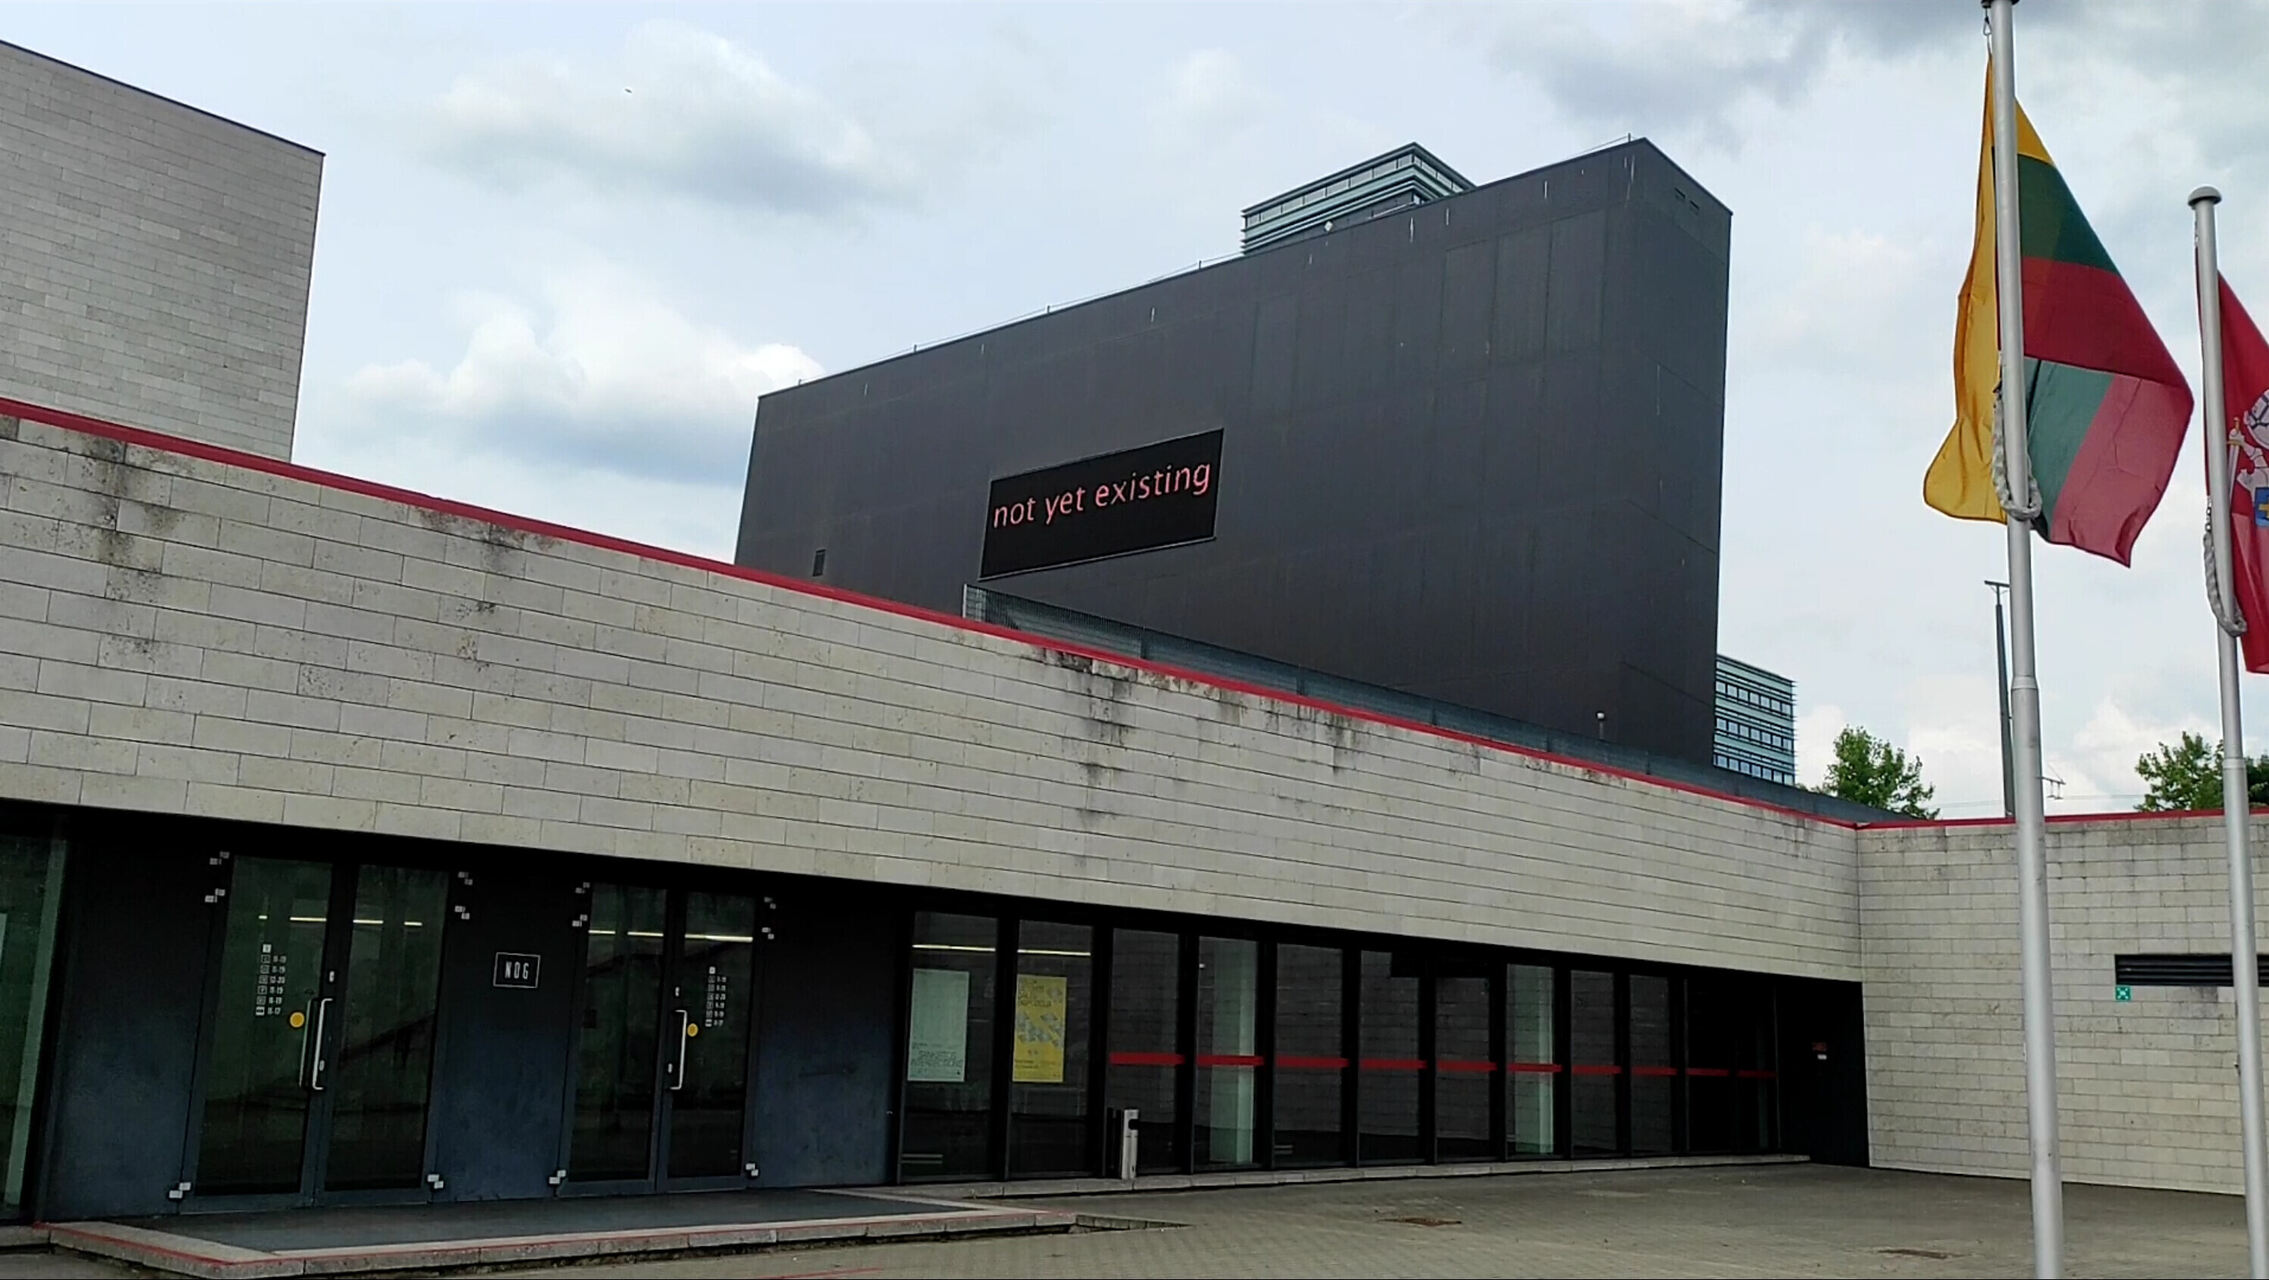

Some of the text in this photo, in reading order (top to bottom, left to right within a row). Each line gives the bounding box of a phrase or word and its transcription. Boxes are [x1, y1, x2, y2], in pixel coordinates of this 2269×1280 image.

[993, 463, 1211, 528] not yet existing
